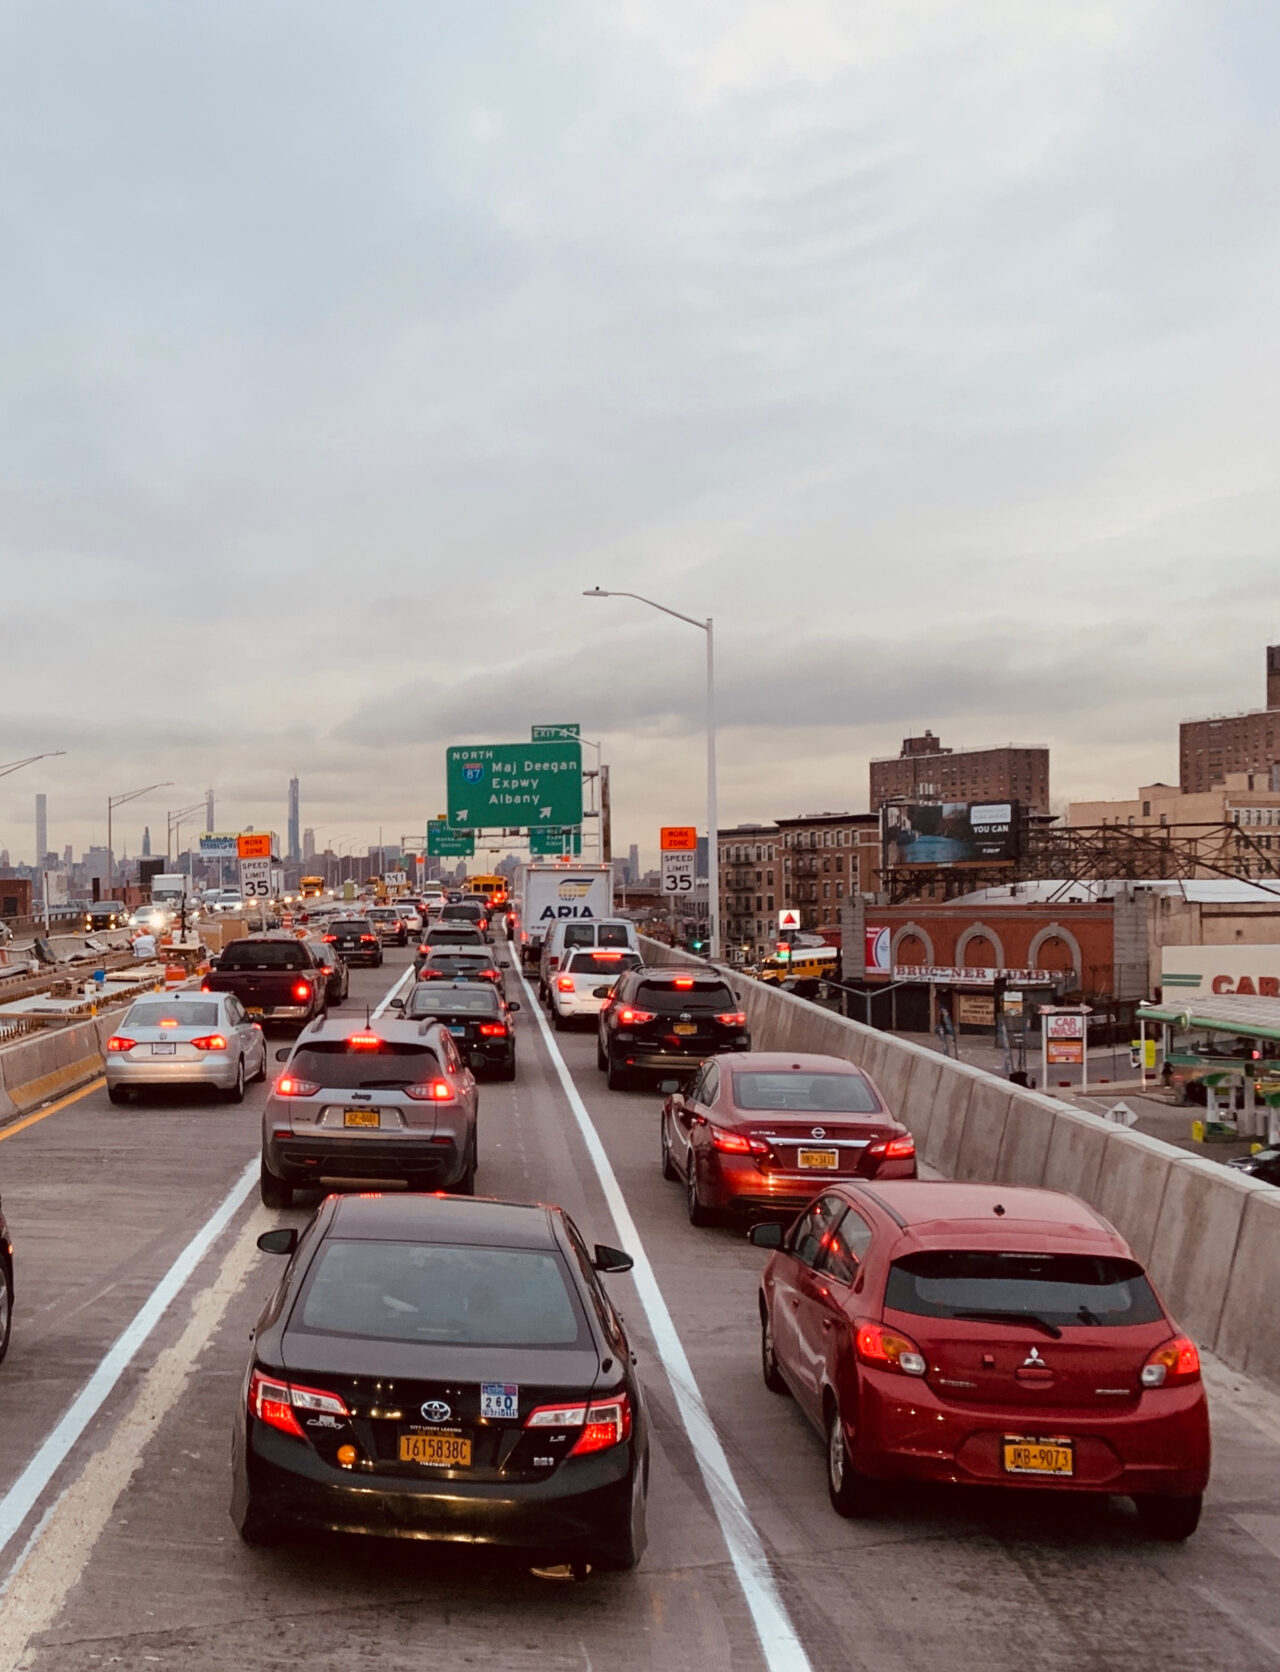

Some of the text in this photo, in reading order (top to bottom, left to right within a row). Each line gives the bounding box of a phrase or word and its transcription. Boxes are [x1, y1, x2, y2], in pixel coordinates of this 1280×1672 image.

[533, 729, 556, 738] EXIT
[452, 751, 493, 760] NORTH
[492, 761, 577, 775] Maj Deegan
[466, 769, 480, 780] 87
[492, 778, 539, 789] Expwy
[489, 794, 540, 805] Albany
[973, 824, 1009, 833] YOU CAN
[667, 865, 689, 873] LIMIT
[245, 881, 269, 896] 35
[665, 875, 692, 891] 35
[539, 905, 594, 920] ARIA
[1212, 975, 1280, 997] CAR
[1055, 1017, 1076, 1026] CAR
[1050, 1027, 1081, 1036] WASH
[405, 1437, 467, 1460] T615838C
